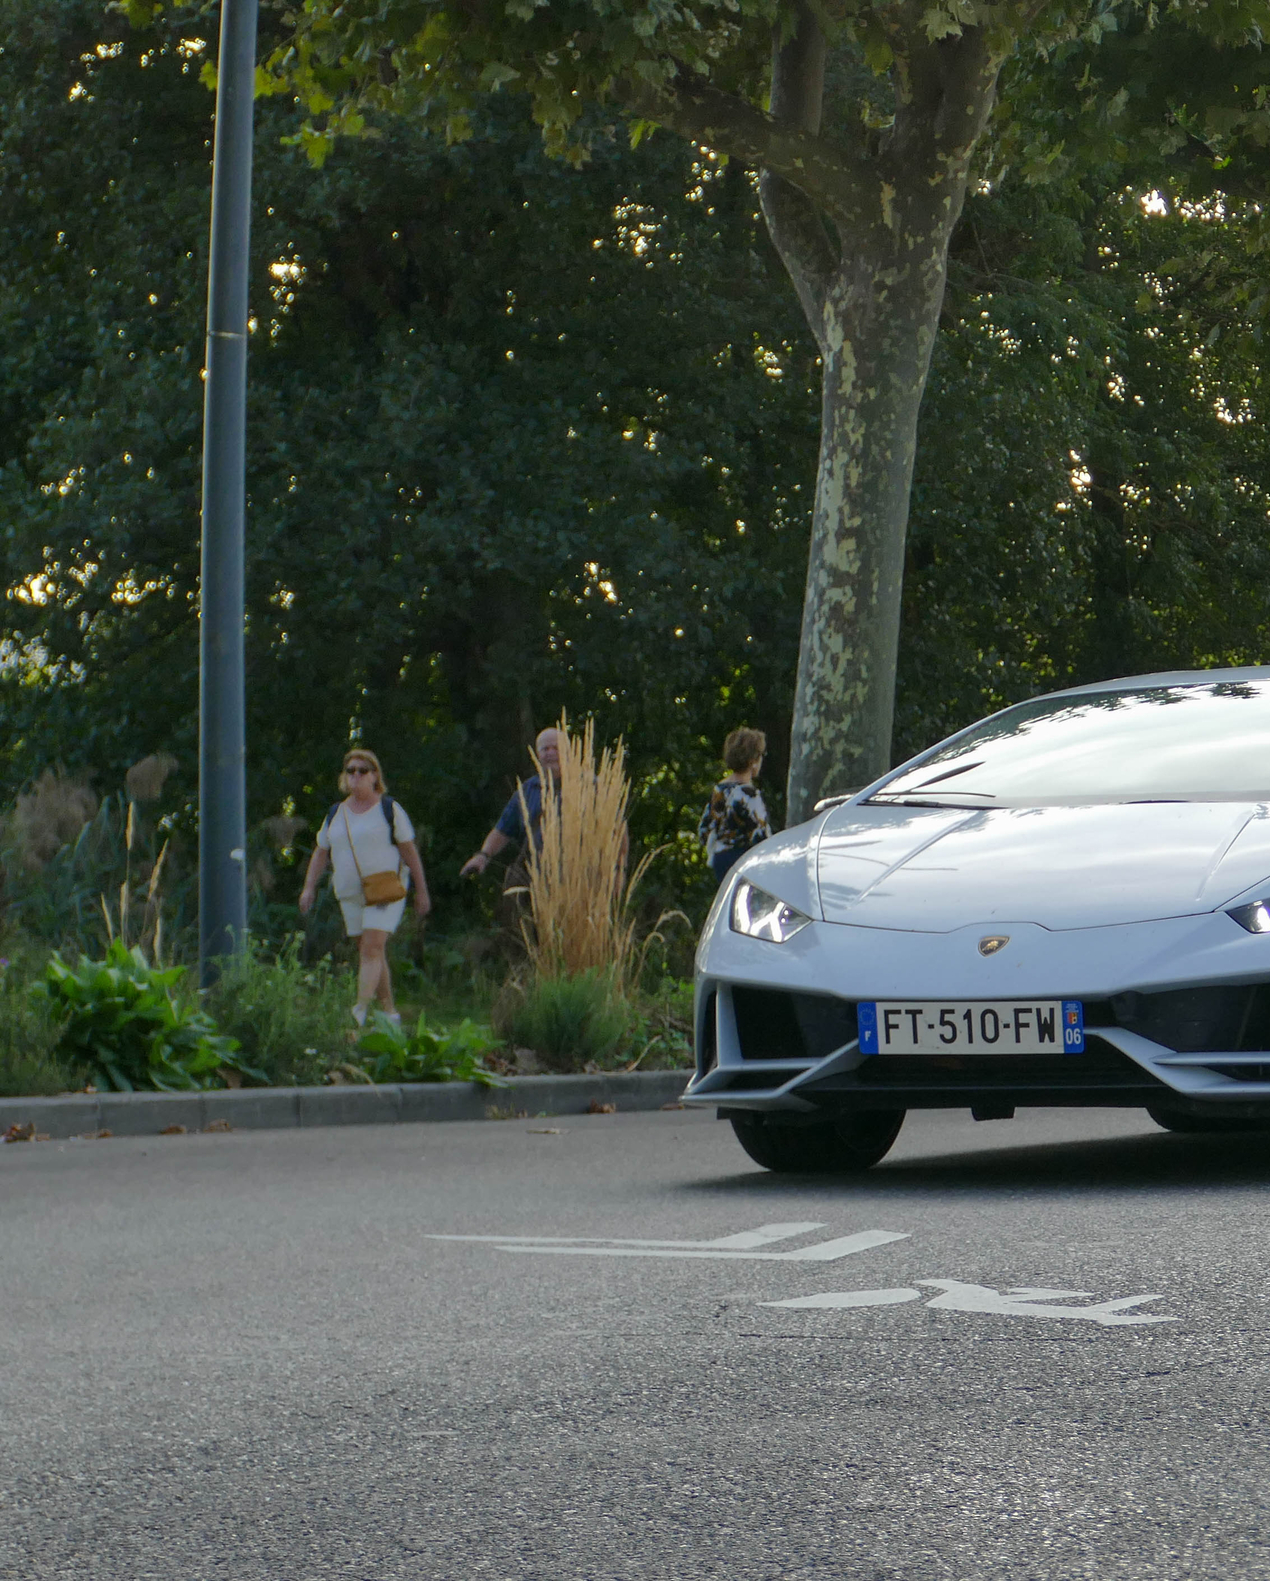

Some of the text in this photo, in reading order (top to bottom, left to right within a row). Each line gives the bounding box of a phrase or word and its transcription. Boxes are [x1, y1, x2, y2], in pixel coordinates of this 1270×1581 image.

[883, 1008, 1055, 1045] FT-510-FW
[864, 1031, 872, 1042] F
[1065, 1028, 1082, 1045] 06
